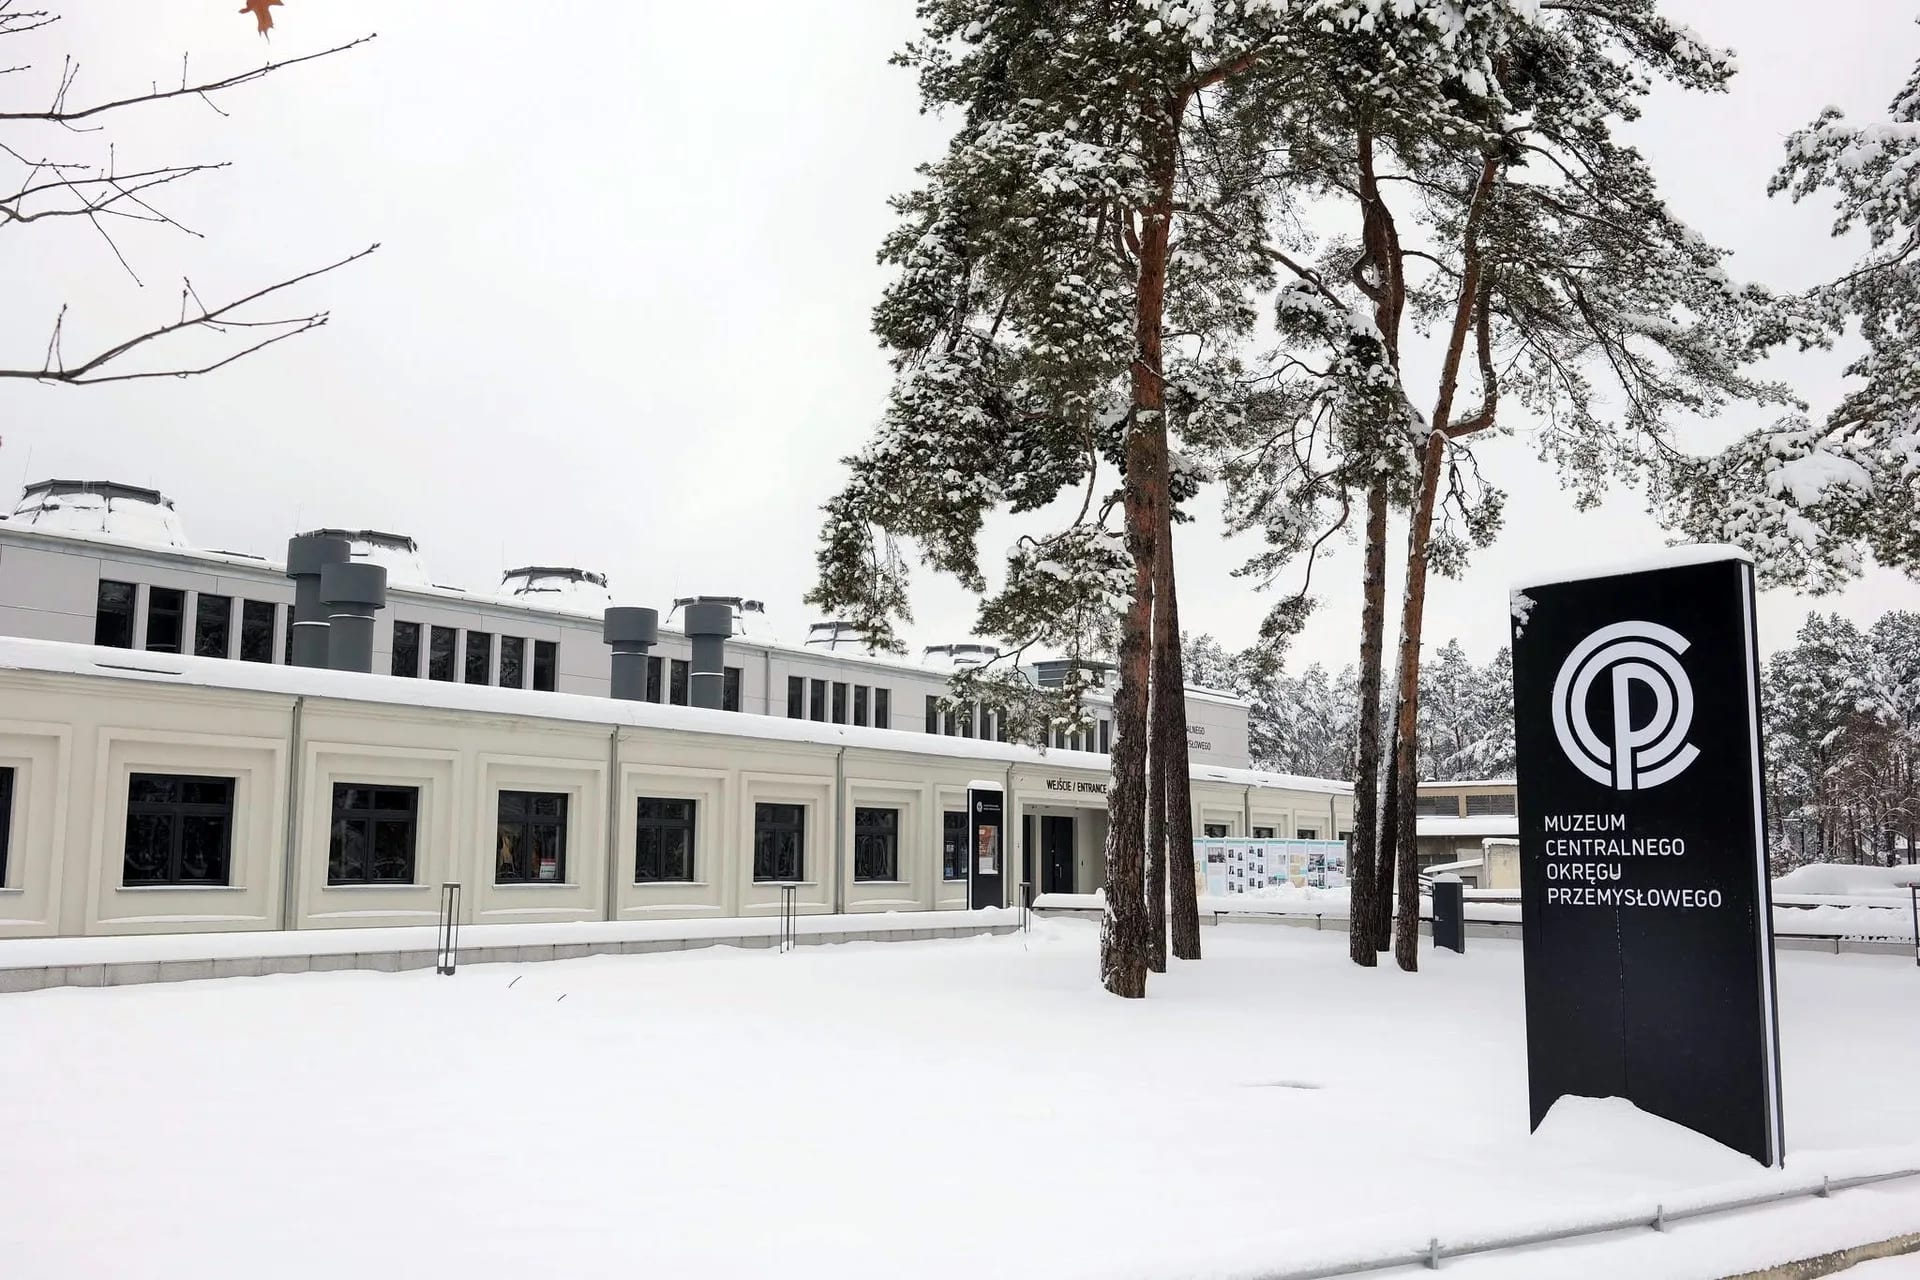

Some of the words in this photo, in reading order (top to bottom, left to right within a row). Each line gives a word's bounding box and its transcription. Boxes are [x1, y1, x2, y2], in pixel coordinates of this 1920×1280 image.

[1046, 778, 1071, 792] WEJŚCIE
[1077, 783, 1107, 794] ENTRANCE
[1544, 814, 1626, 832] MUZEUM
[1546, 838, 1685, 857] CENTRALNEGO
[1547, 863, 1622, 884] OKRĘGU
[1548, 888, 1722, 908] PRZEMYSŁOWEGO
